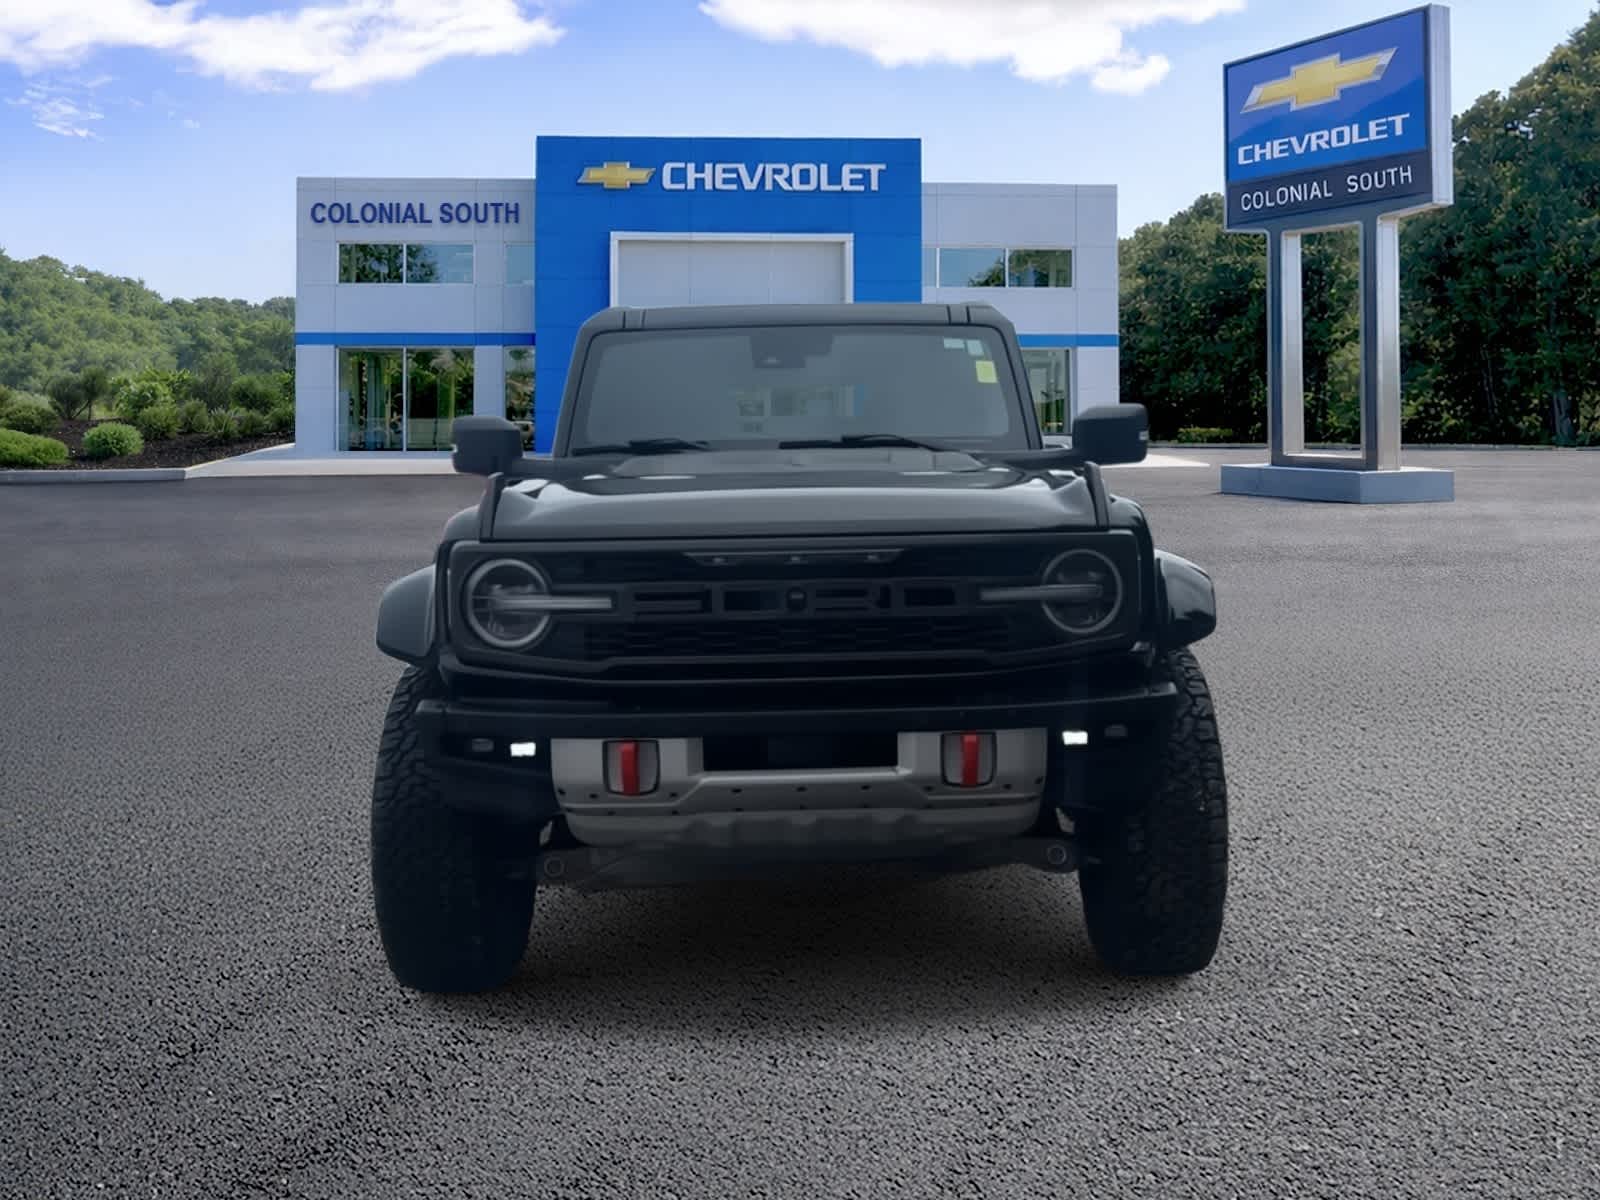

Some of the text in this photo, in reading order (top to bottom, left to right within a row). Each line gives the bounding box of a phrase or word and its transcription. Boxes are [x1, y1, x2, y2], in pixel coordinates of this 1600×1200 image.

[1237, 113, 1410, 165] CHEVROLET
[662, 162, 887, 191] CHEVROLET
[1240, 165, 1412, 211] COLONIAL SOUTH
[310, 202, 520, 223] COLONIAL SOUTH
